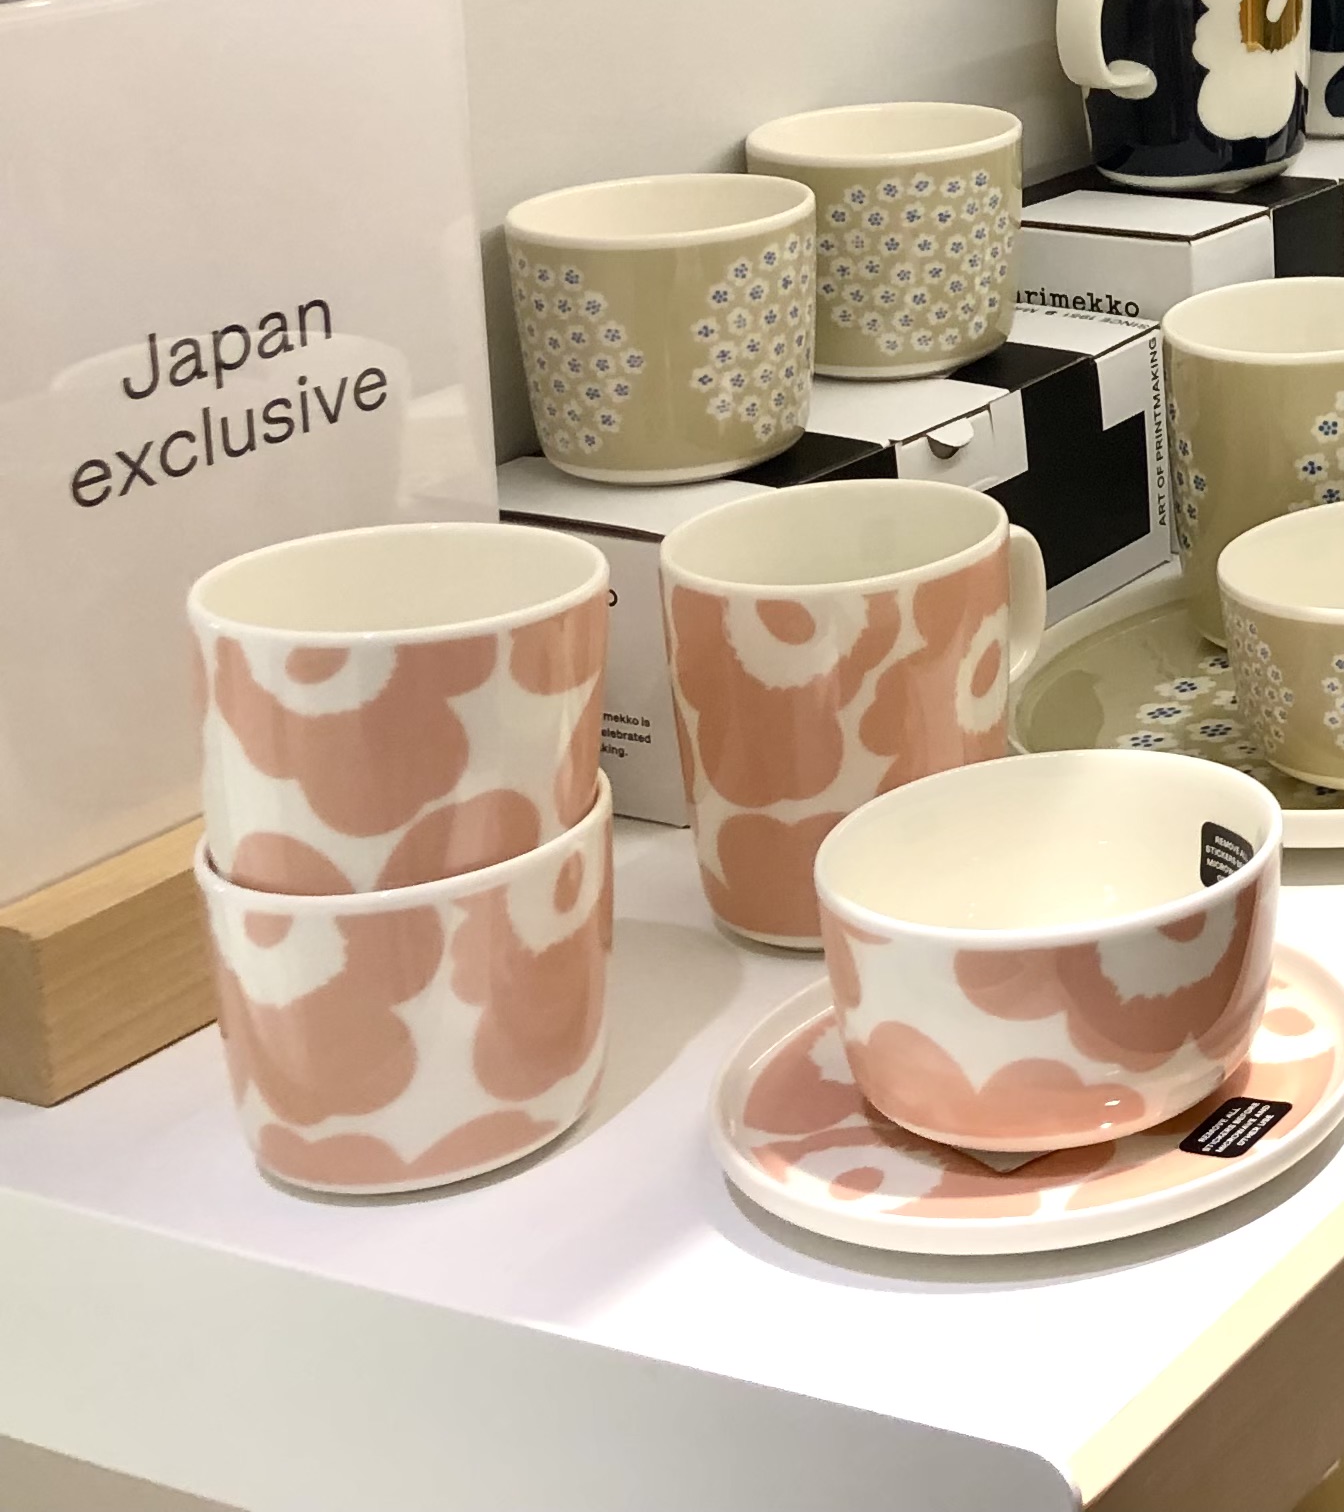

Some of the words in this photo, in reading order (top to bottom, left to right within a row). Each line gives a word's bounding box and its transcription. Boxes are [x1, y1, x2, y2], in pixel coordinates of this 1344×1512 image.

[1016, 287, 1140, 318] rimekko
[122, 299, 332, 400] Japan
[1149, 336, 1163, 462] PRINTMAKING
[71, 367, 388, 507] exclusive
[1157, 466, 1166, 488] OF
[1157, 493, 1167, 526] ART
